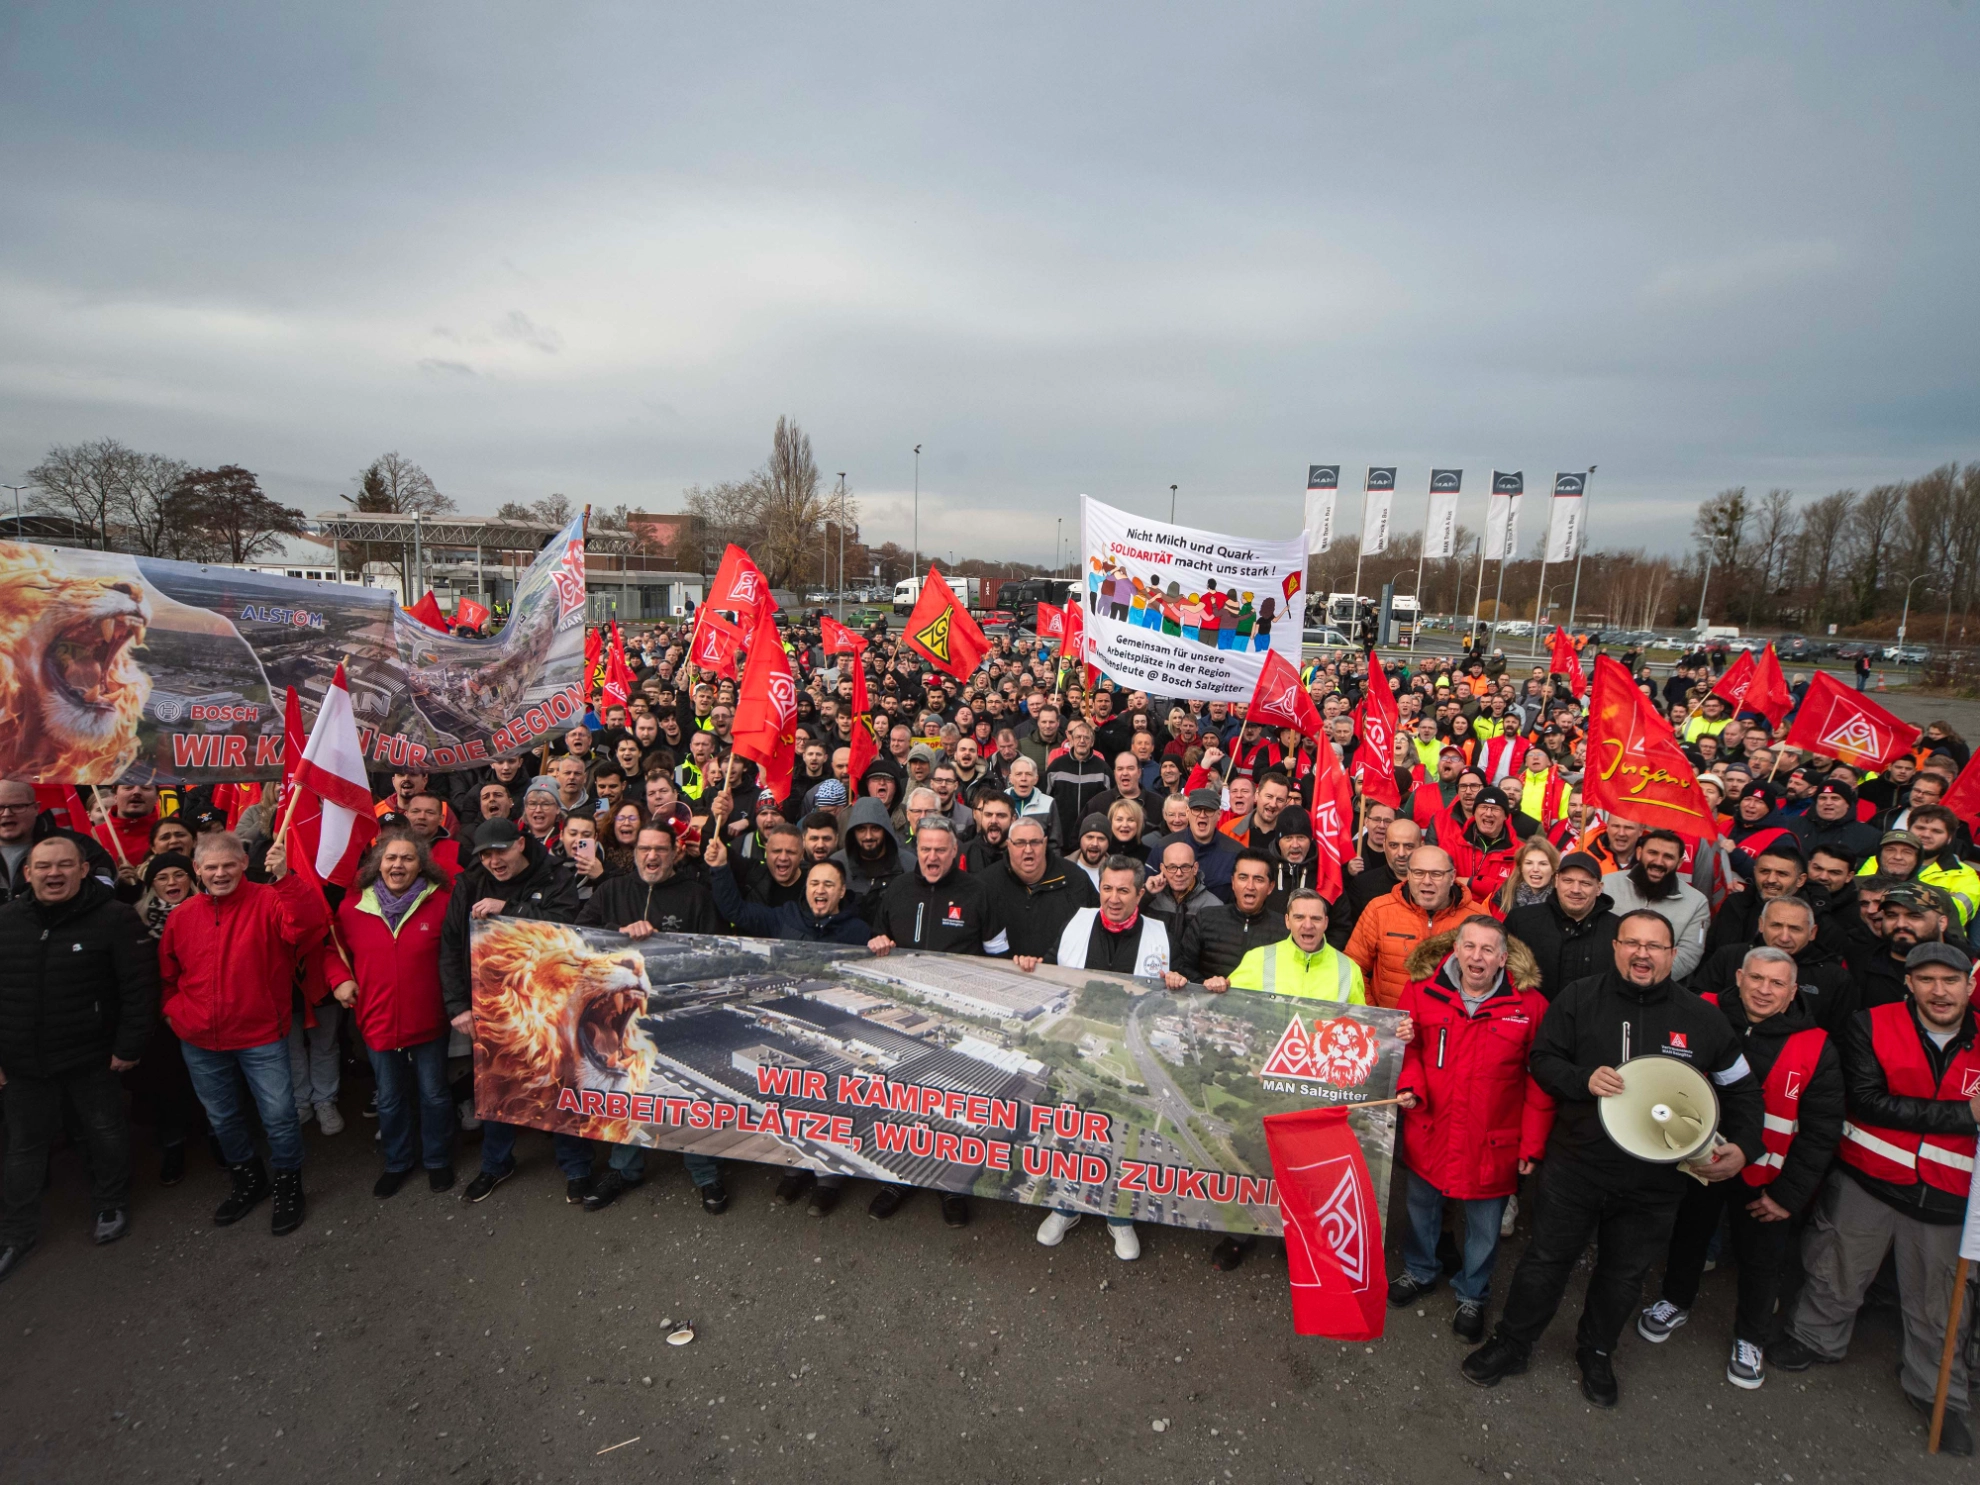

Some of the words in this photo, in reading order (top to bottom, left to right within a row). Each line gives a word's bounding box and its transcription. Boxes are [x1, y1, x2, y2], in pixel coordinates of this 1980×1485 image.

[1110, 541, 1174, 565] SOLIDARITÄT
[1175, 557, 1213, 572] macht
[1216, 564, 1238, 575] uns
[1240, 565, 1269, 576] stark
[1126, 528, 1153, 542] Nicht
[1155, 533, 1187, 549] Milch
[1190, 541, 1214, 555] und
[1217, 546, 1254, 561] Quark
[241, 605, 323, 627] ALSTOM
[1107, 645, 1164, 668] Arbeitsplätze
[1166, 659, 1176, 670] in
[1178, 662, 1196, 674] der
[1198, 666, 1231, 679] Region
[1116, 634, 1171, 656] Gemeinsam
[1173, 647, 1188, 659] für
[1190, 652, 1225, 664] unsere
[1147, 670, 1159, 681] @
[1161, 673, 1192, 688] Bosch
[1194, 680, 1245, 693] Salzgitter
[191, 704, 258, 722] BOSCH
[373, 732, 427, 768] FÜR
[432, 739, 489, 767] DIE
[491, 681, 585, 754] REGION
[173, 734, 247, 767] WIR
[757, 1065, 828, 1102] WIR
[837, 1074, 1018, 1131] KÄMPFEN
[1029, 1102, 1113, 1144] FÜR
[1263, 1080, 1296, 1094] MAN
[1300, 1084, 1369, 1101] Salzgitter
[557, 1087, 863, 1154] ARBEITSPLÄTZE,
[873, 1120, 1011, 1171] WÜRDE
[1022, 1146, 1109, 1185] UND
